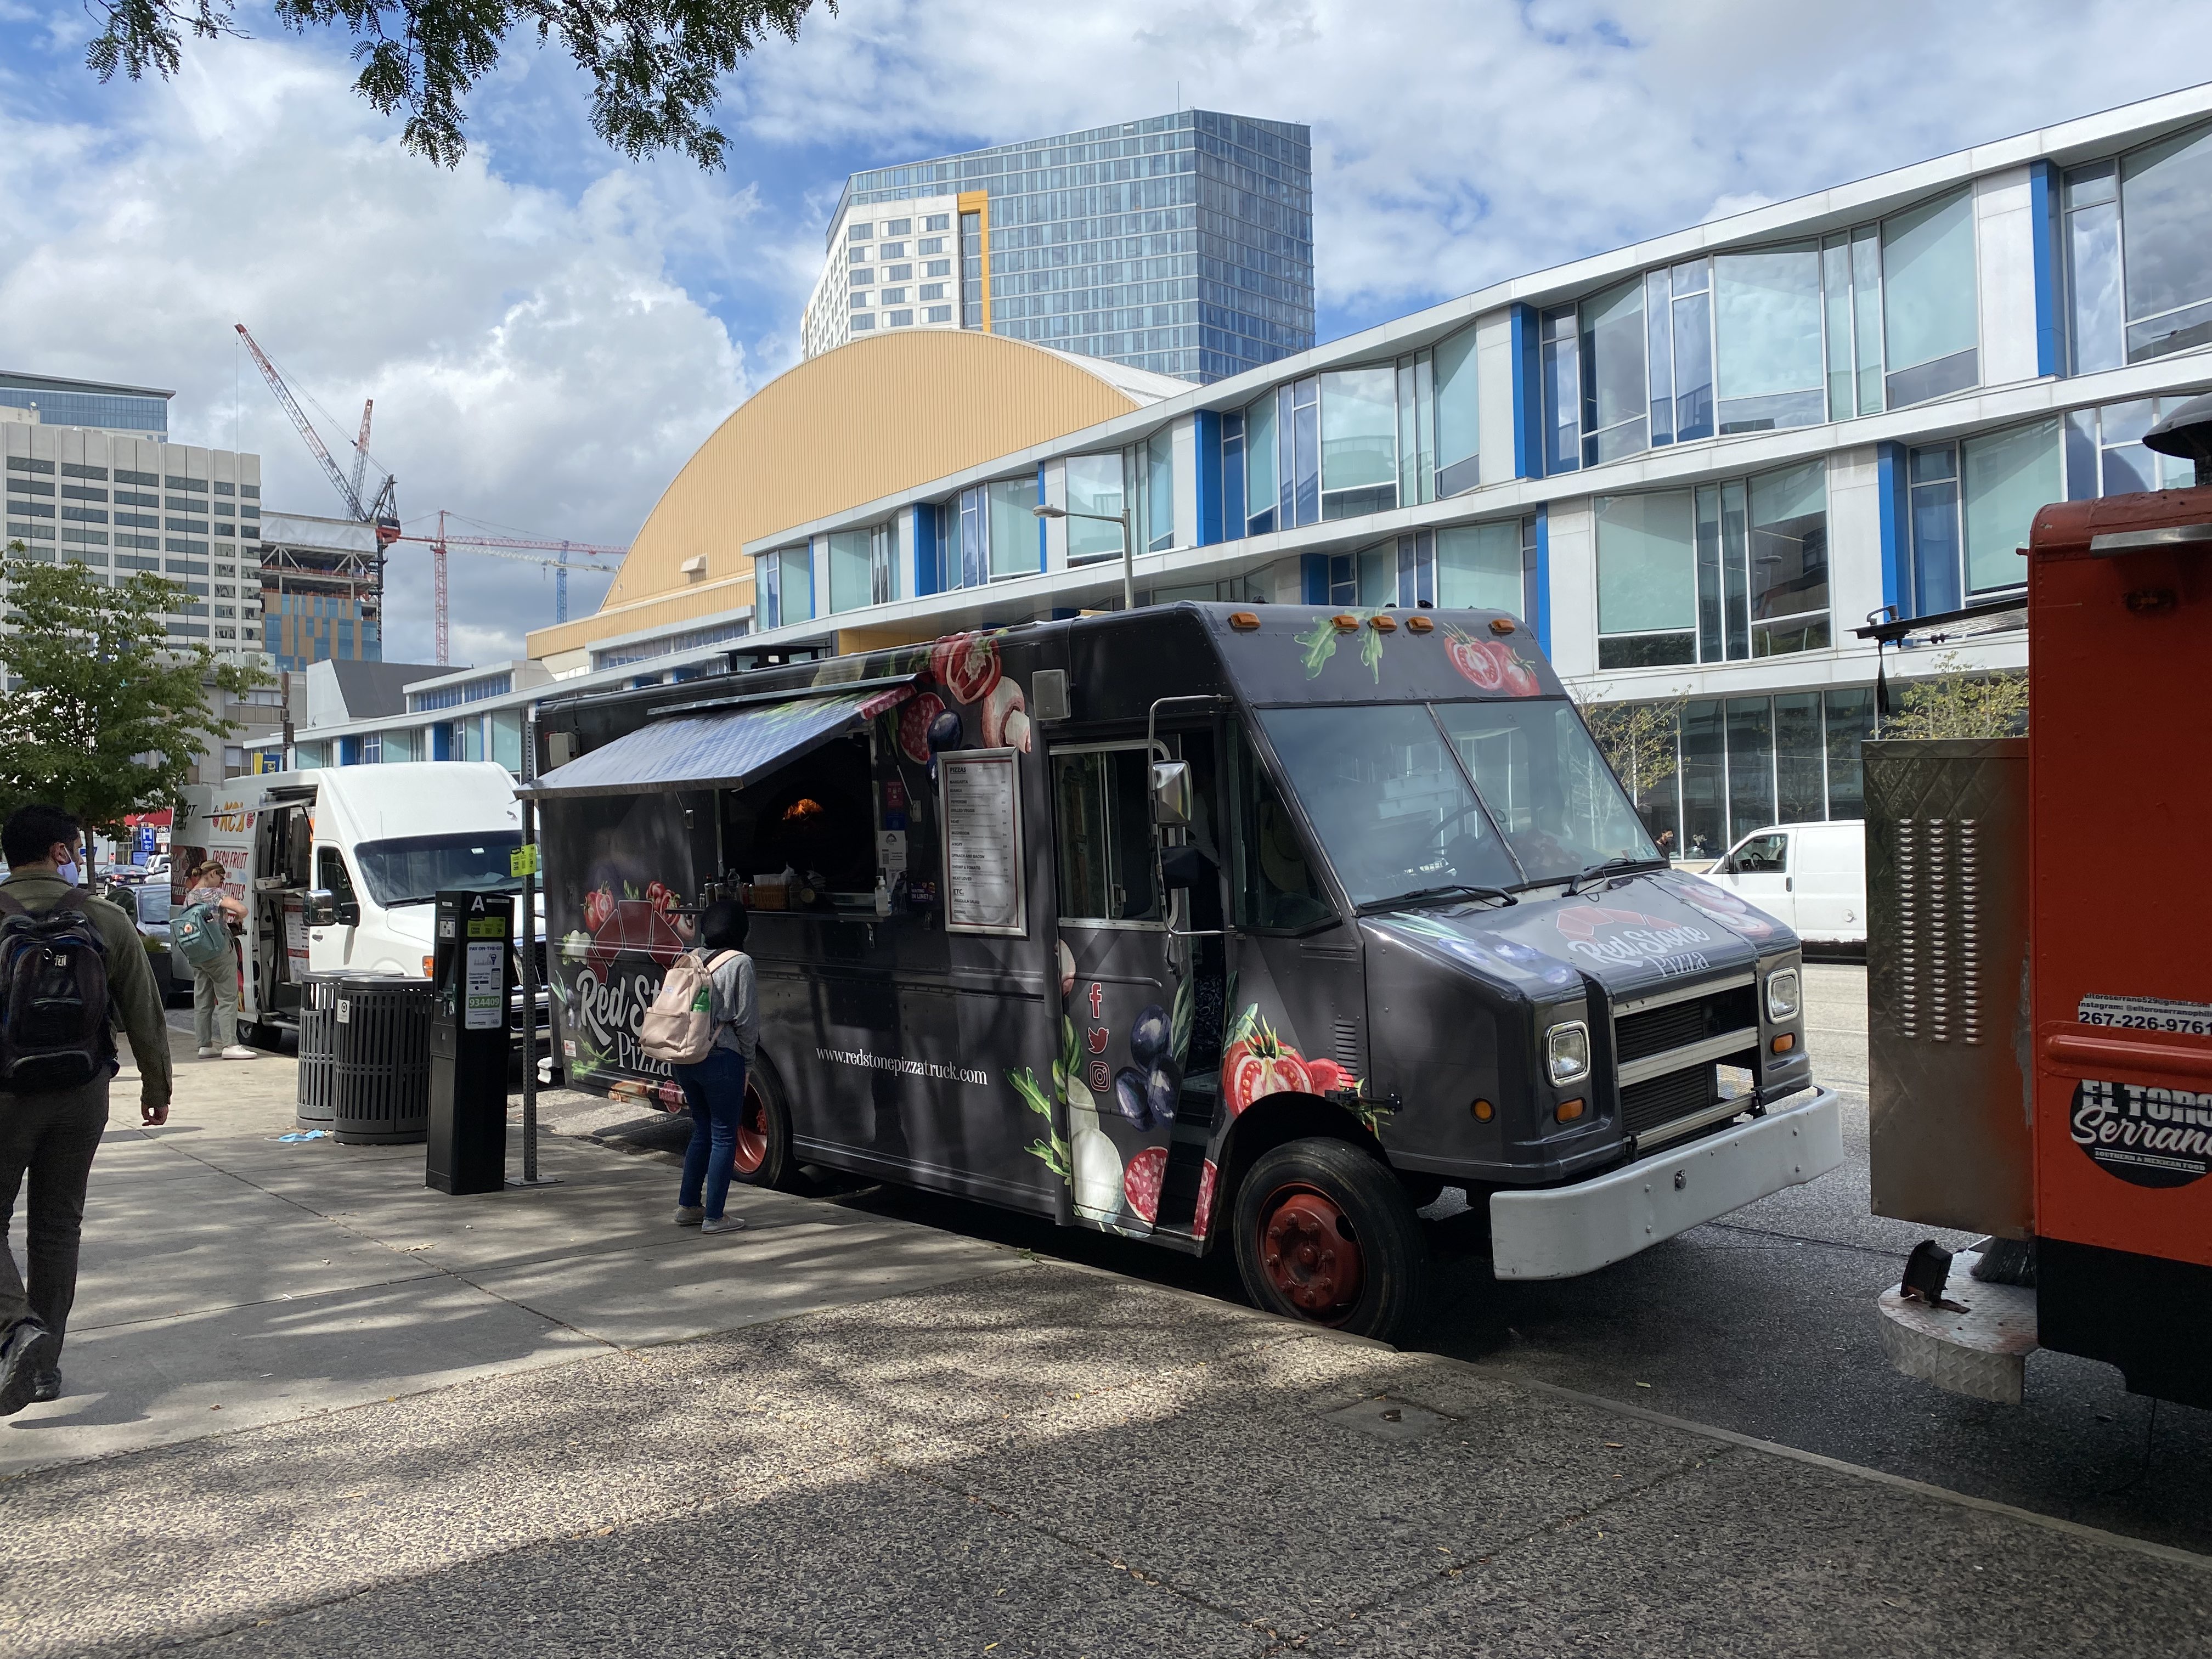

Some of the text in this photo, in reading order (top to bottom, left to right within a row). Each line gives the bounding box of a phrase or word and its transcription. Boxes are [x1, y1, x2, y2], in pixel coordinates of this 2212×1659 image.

[143, 828, 152, 839] H
[230, 851, 249, 869] FRUIT
[471, 895, 485, 911] A
[1567, 926, 1711, 967] Red Stone
[1644, 951, 1711, 978] Pizza
[469, 997, 499, 1007] 934409
[576, 969, 629, 1046] Red
[816, 1048, 988, 1086] www.redstonepizzatruck.com
[2081, 1079, 2119, 1114] EL
[2095, 1150, 2135, 1161] SOUTHERN
[2183, 1163, 2206, 1171] FOOD
